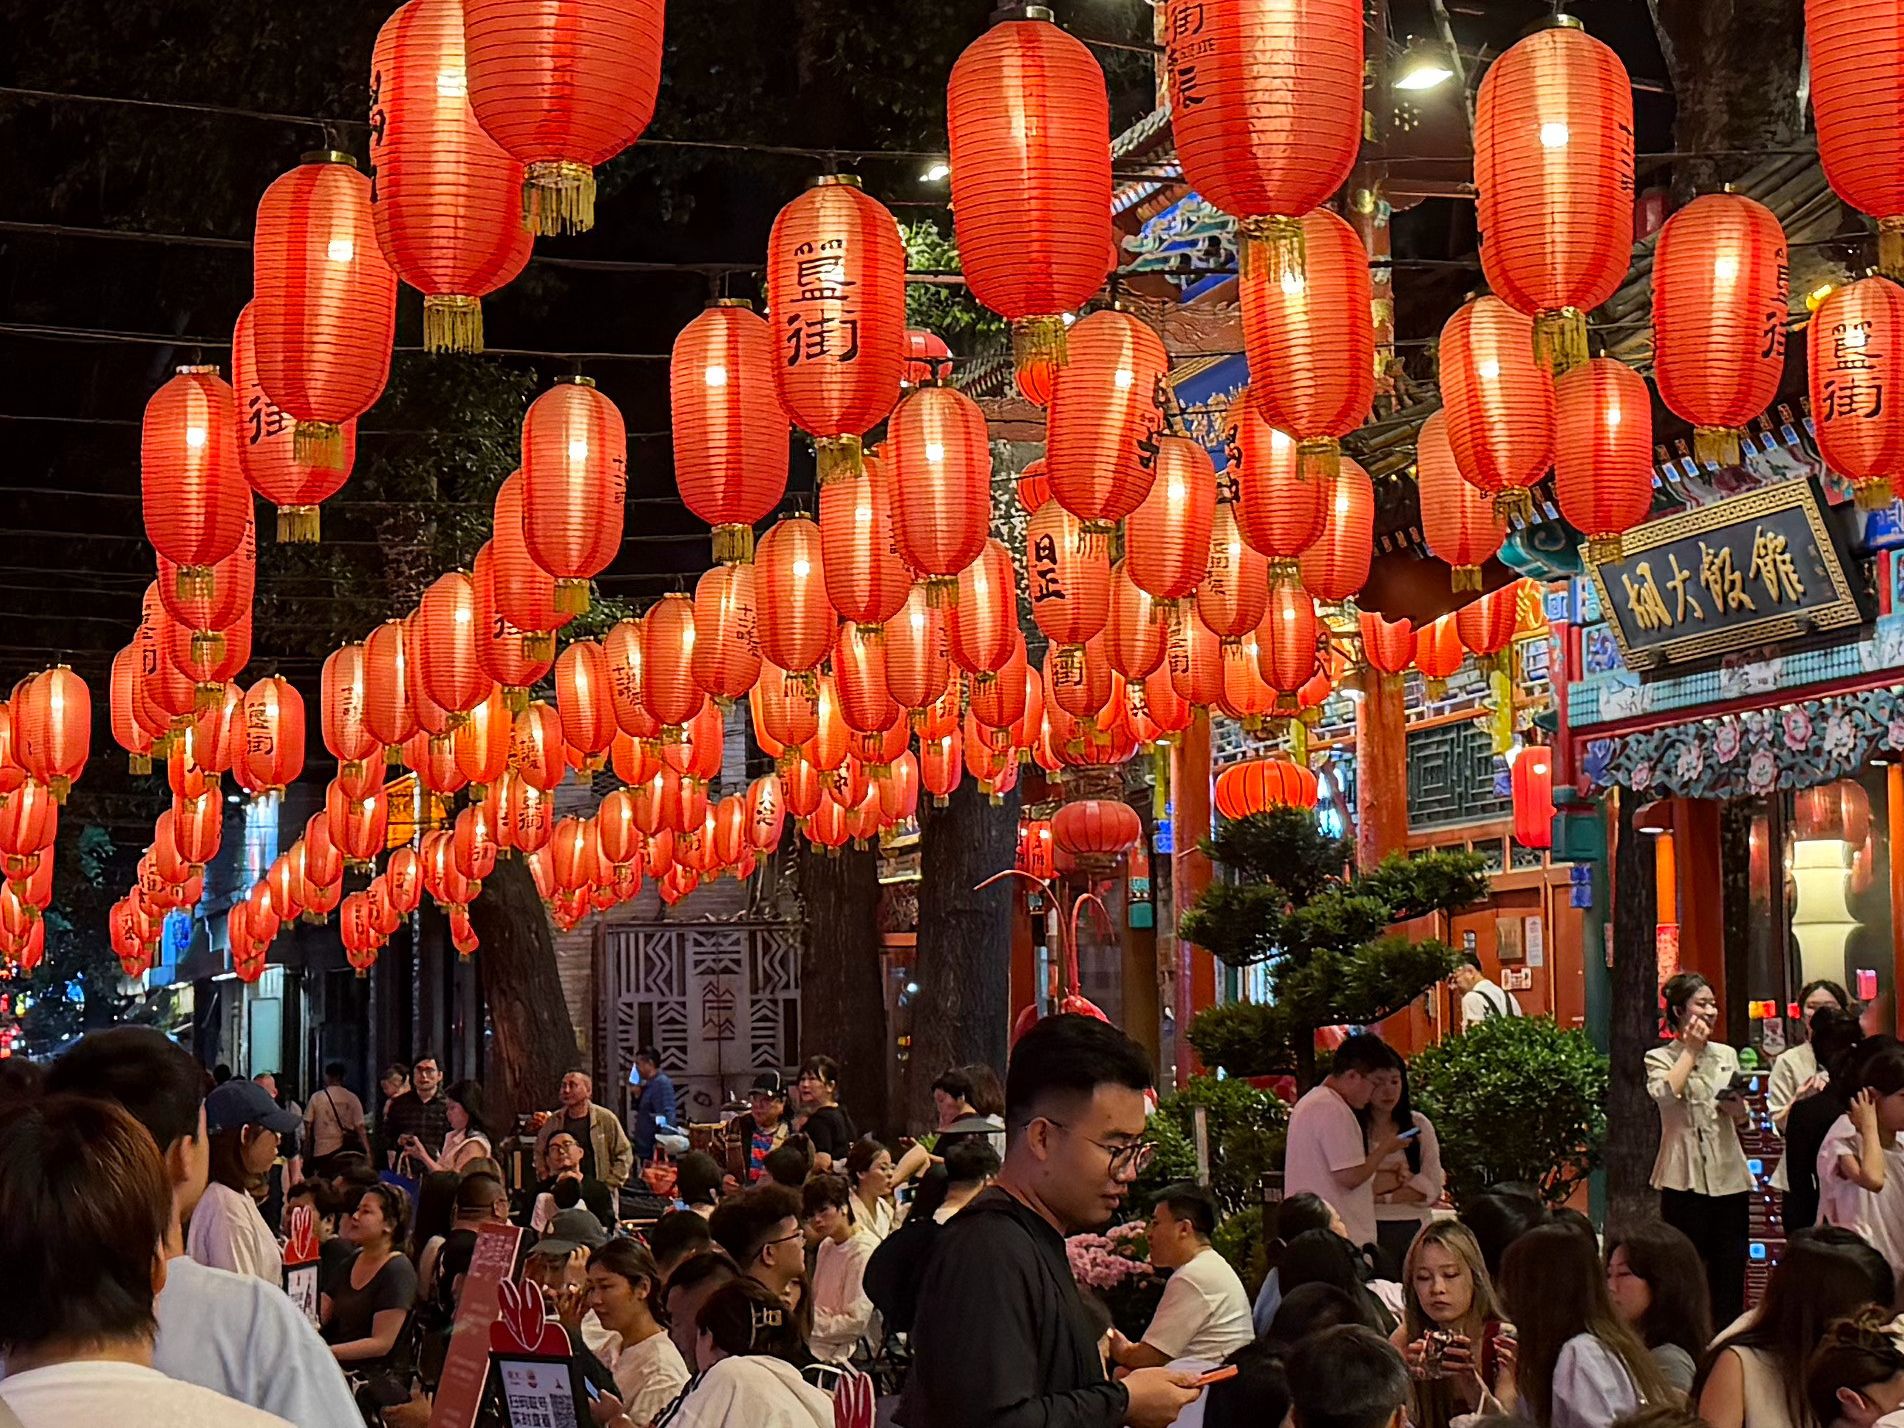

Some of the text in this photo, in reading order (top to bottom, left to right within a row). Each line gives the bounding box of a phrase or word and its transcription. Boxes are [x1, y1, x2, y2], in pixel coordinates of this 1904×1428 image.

[787, 239, 858, 366] 簋街
[1823, 321, 1882, 422] 簋街
[1033, 533, 1066, 602] 日正
